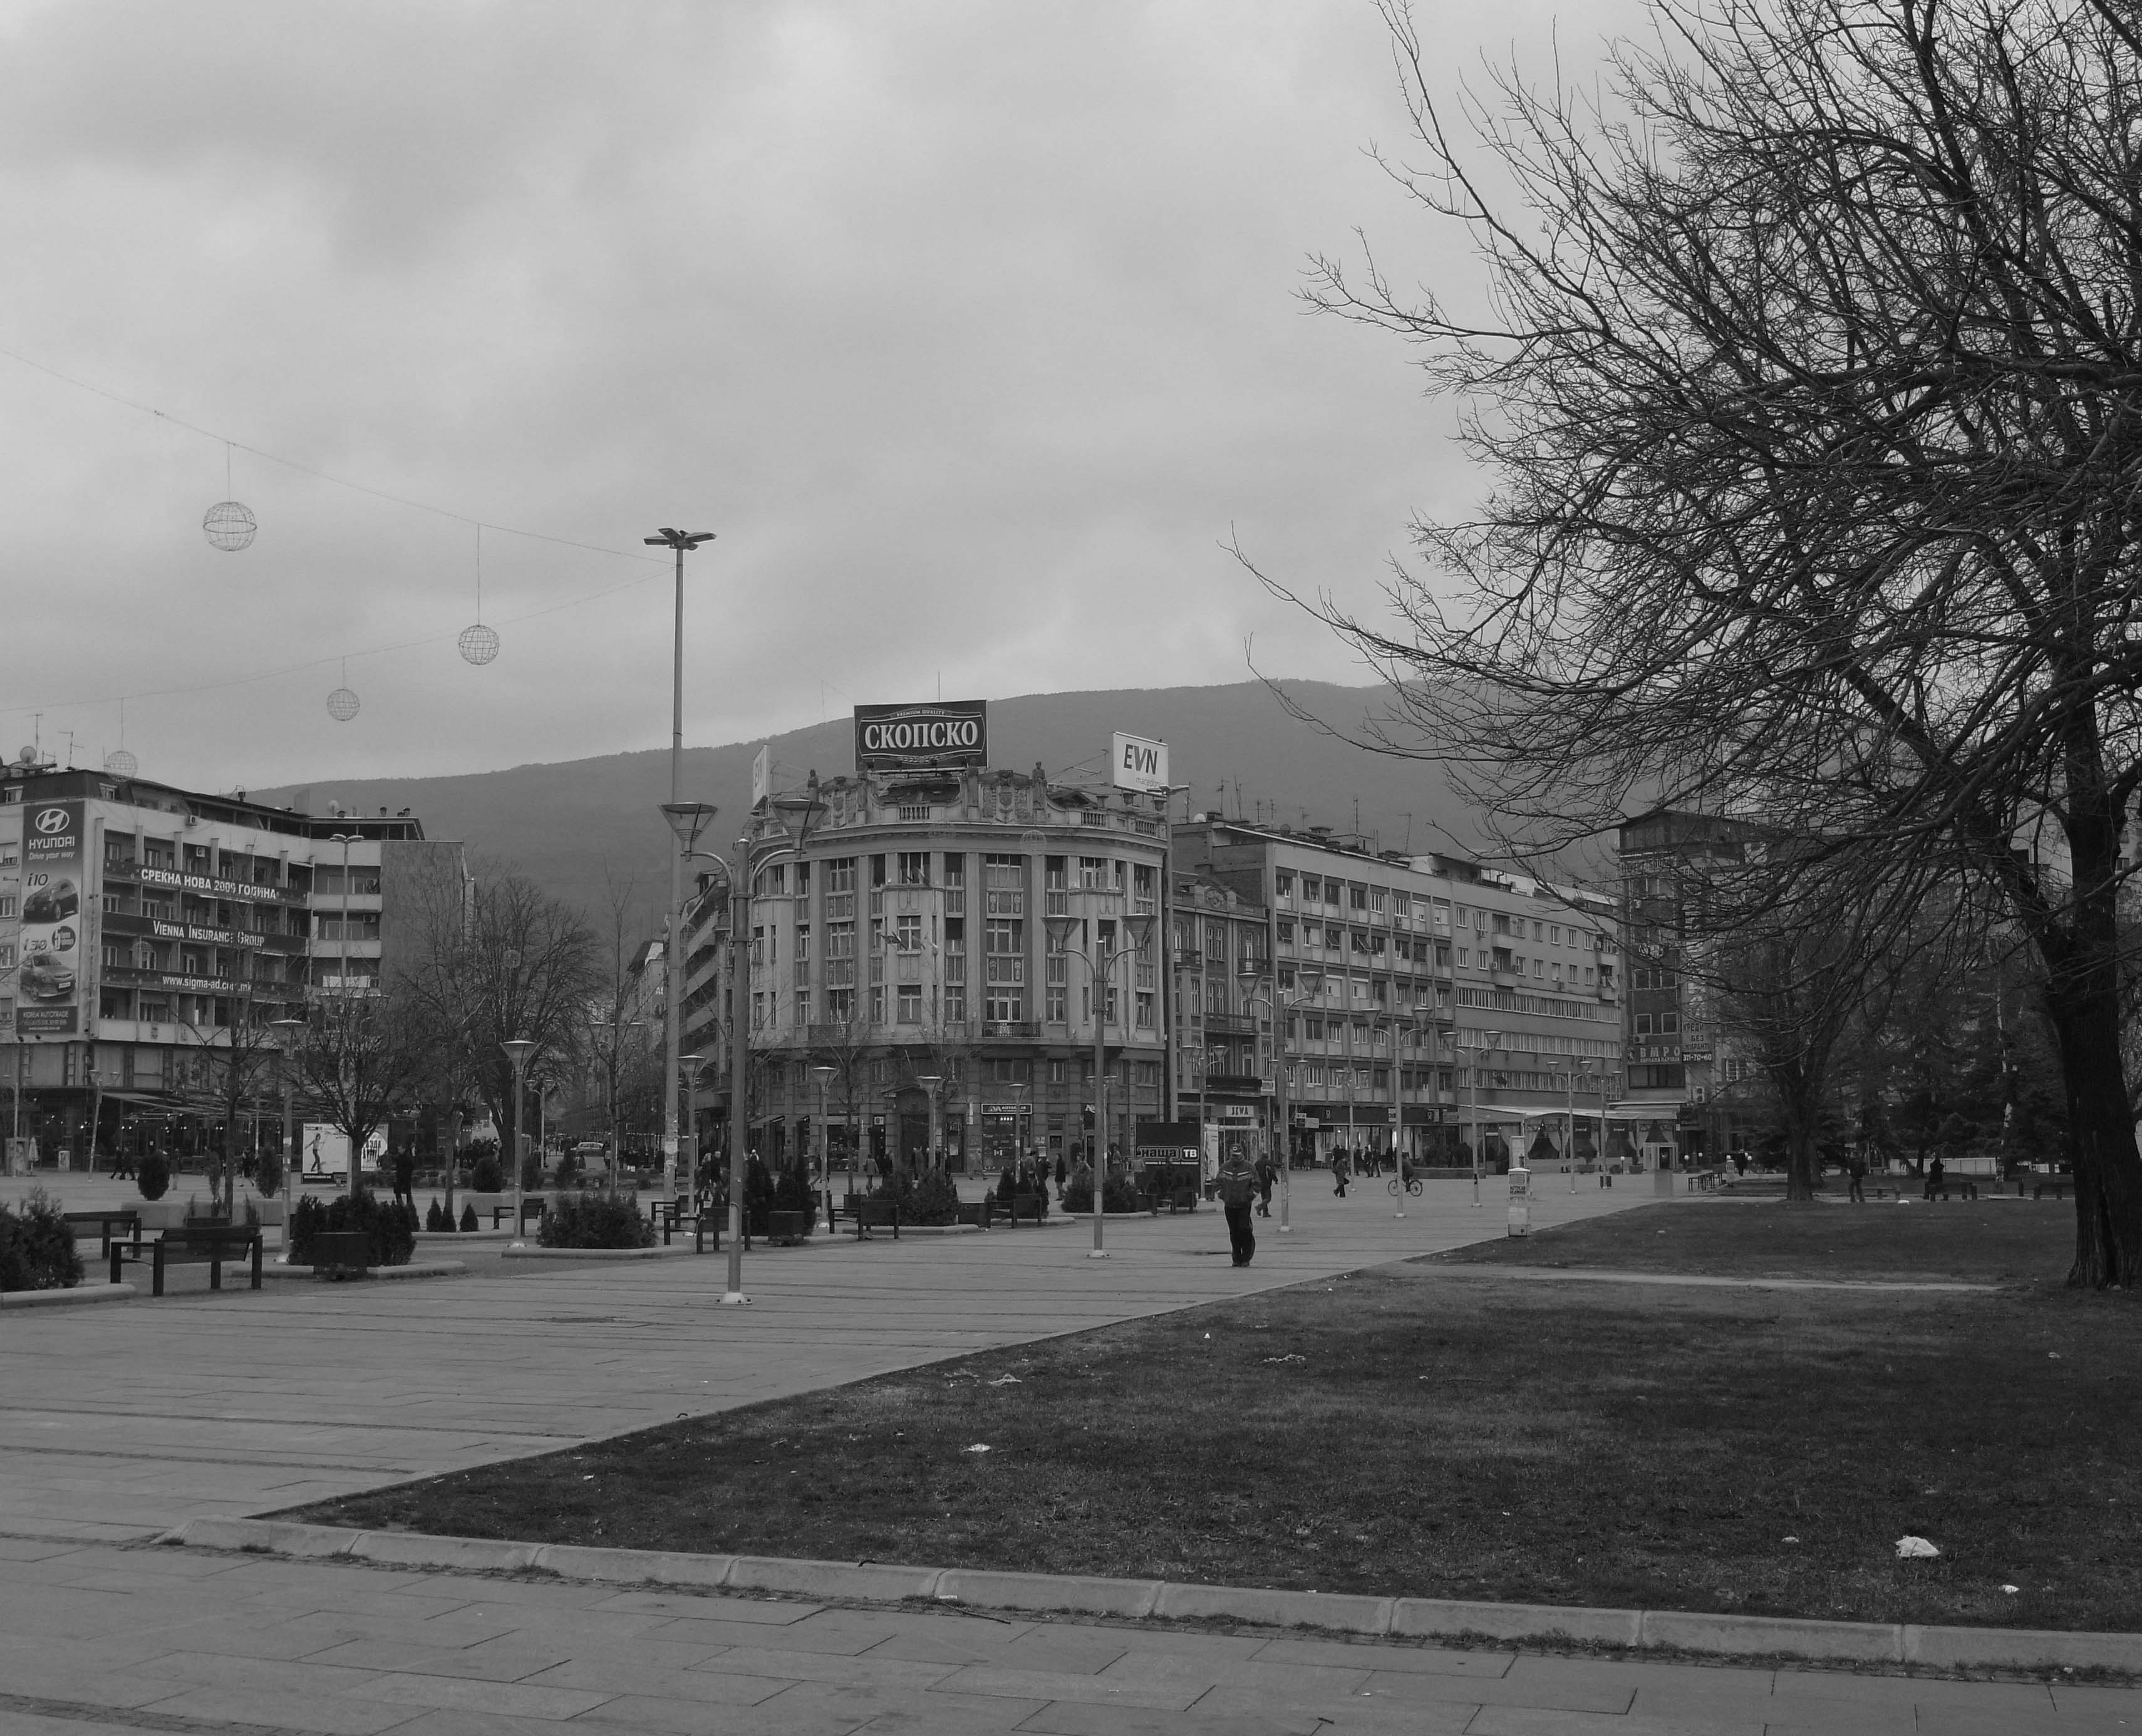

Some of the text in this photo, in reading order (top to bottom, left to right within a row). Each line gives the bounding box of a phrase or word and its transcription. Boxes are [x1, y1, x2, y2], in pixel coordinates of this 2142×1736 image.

[864, 720, 978, 750] СКОПСКО
[1124, 743, 1158, 775] EVN
[29, 836, 75, 850] HYUNDAI
[46, 852, 59, 861] your
[28, 872, 48, 886] i10
[141, 869, 182, 886] СРЕЌНА
[184, 875, 212, 890] НОВА
[238, 884, 276, 899] ГОДИНА
[153, 920, 185, 938] VIENNA
[237, 931, 265, 947] GROUP
[1141, 1149, 1198, 1158] наша ТВ
